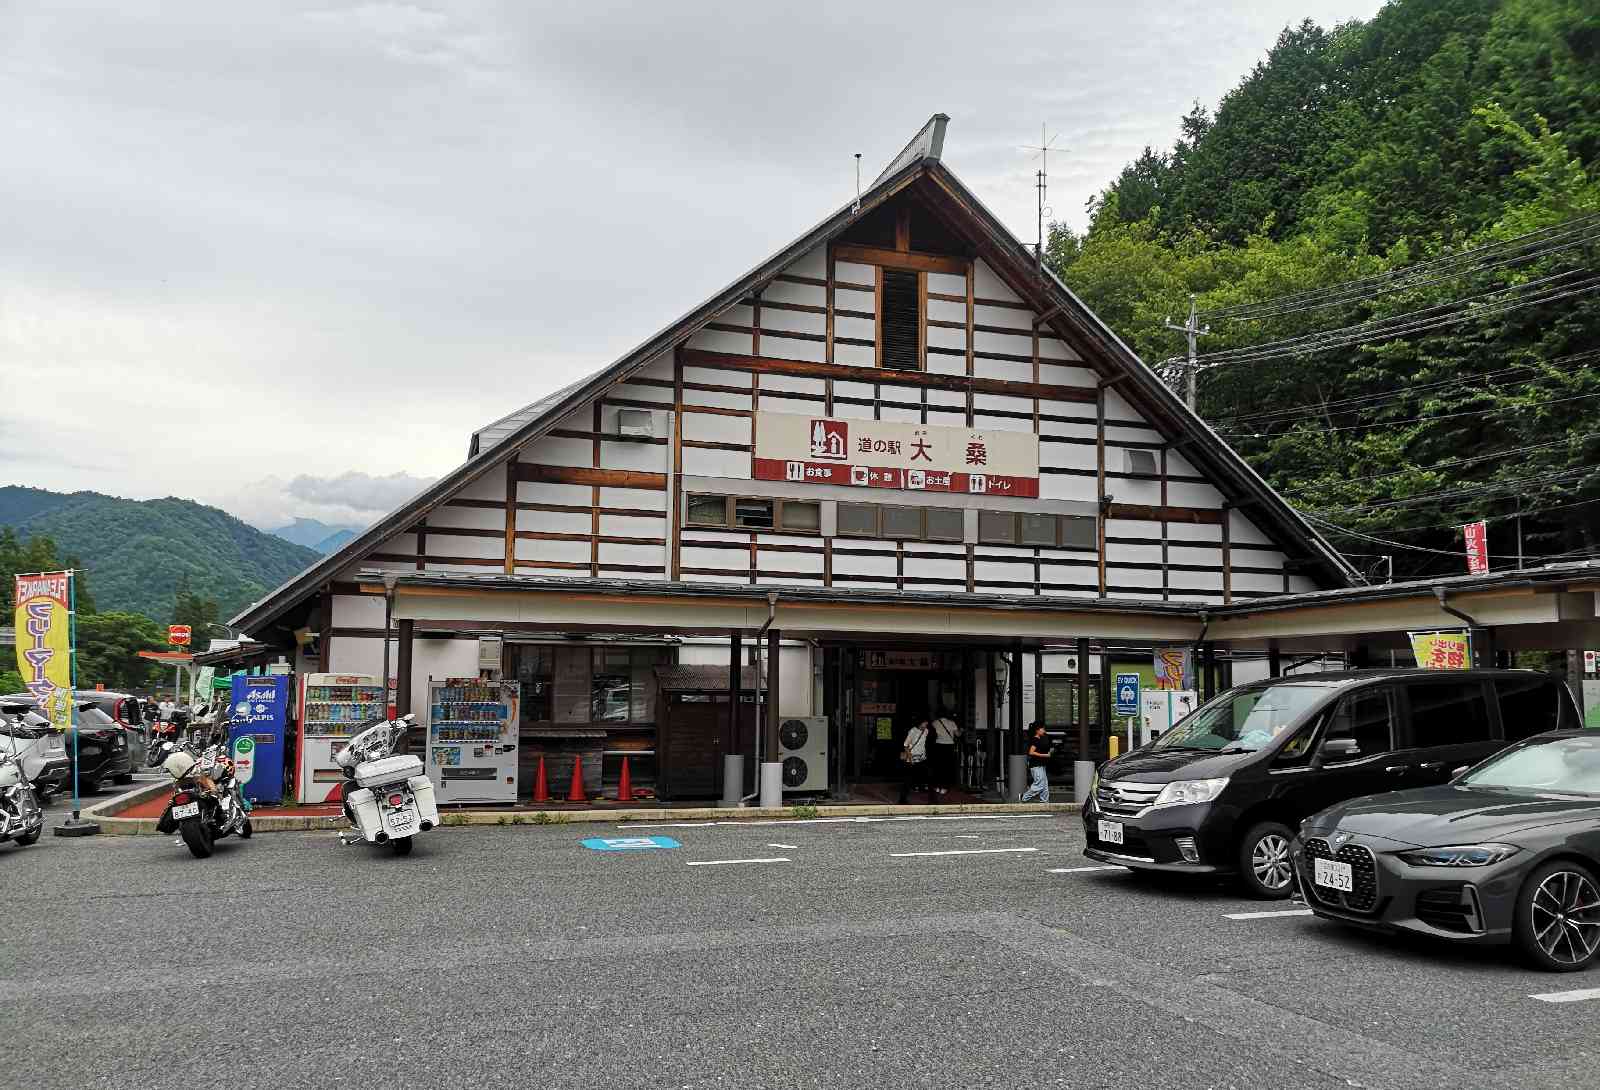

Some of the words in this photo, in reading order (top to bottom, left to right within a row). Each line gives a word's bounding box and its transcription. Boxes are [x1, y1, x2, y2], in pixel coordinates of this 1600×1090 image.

[858, 437, 901, 456] 道の駅
[988, 475, 1011, 489] トイレ
[1323, 871, 1350, 889] 24-52
